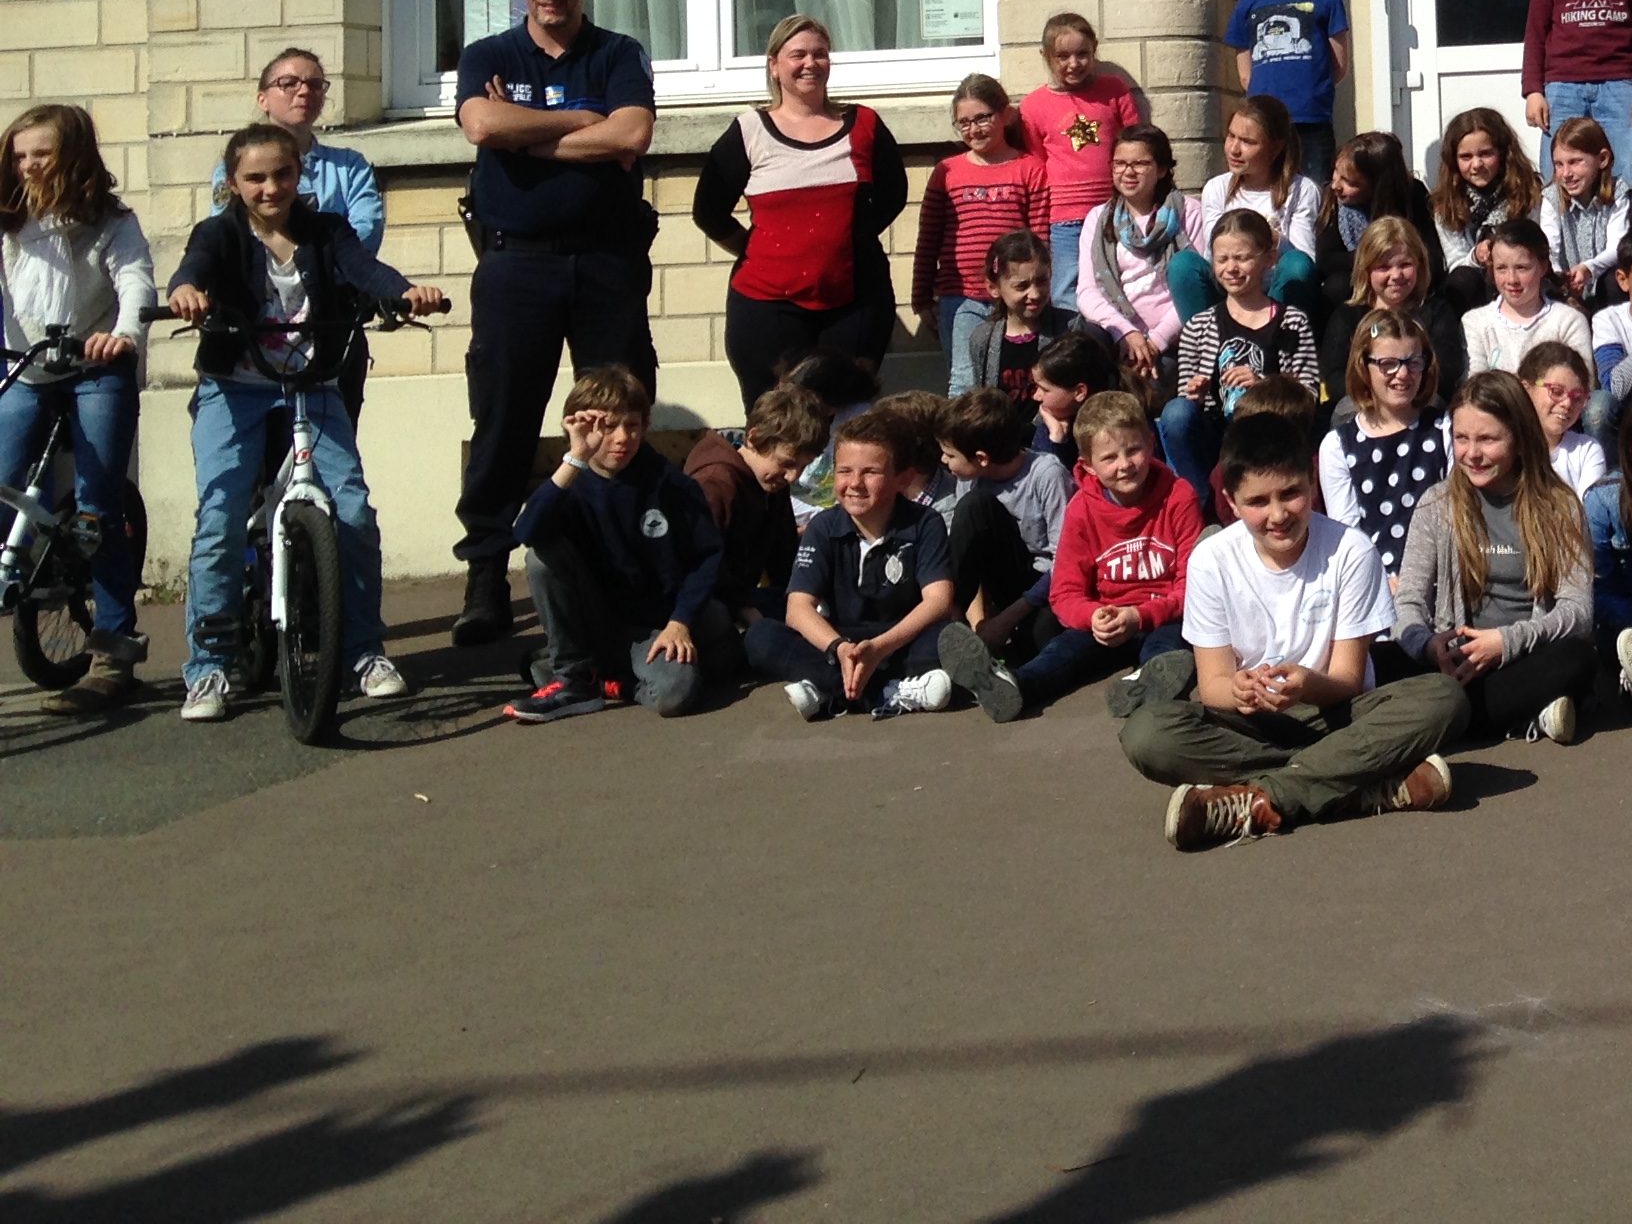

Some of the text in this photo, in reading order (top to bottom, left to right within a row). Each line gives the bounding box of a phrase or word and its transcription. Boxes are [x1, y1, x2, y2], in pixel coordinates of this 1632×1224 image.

[1561, 10, 1596, 24] HIKING
[1598, 9, 1628, 22] CAMP
[1106, 550, 1166, 581] TEAM
